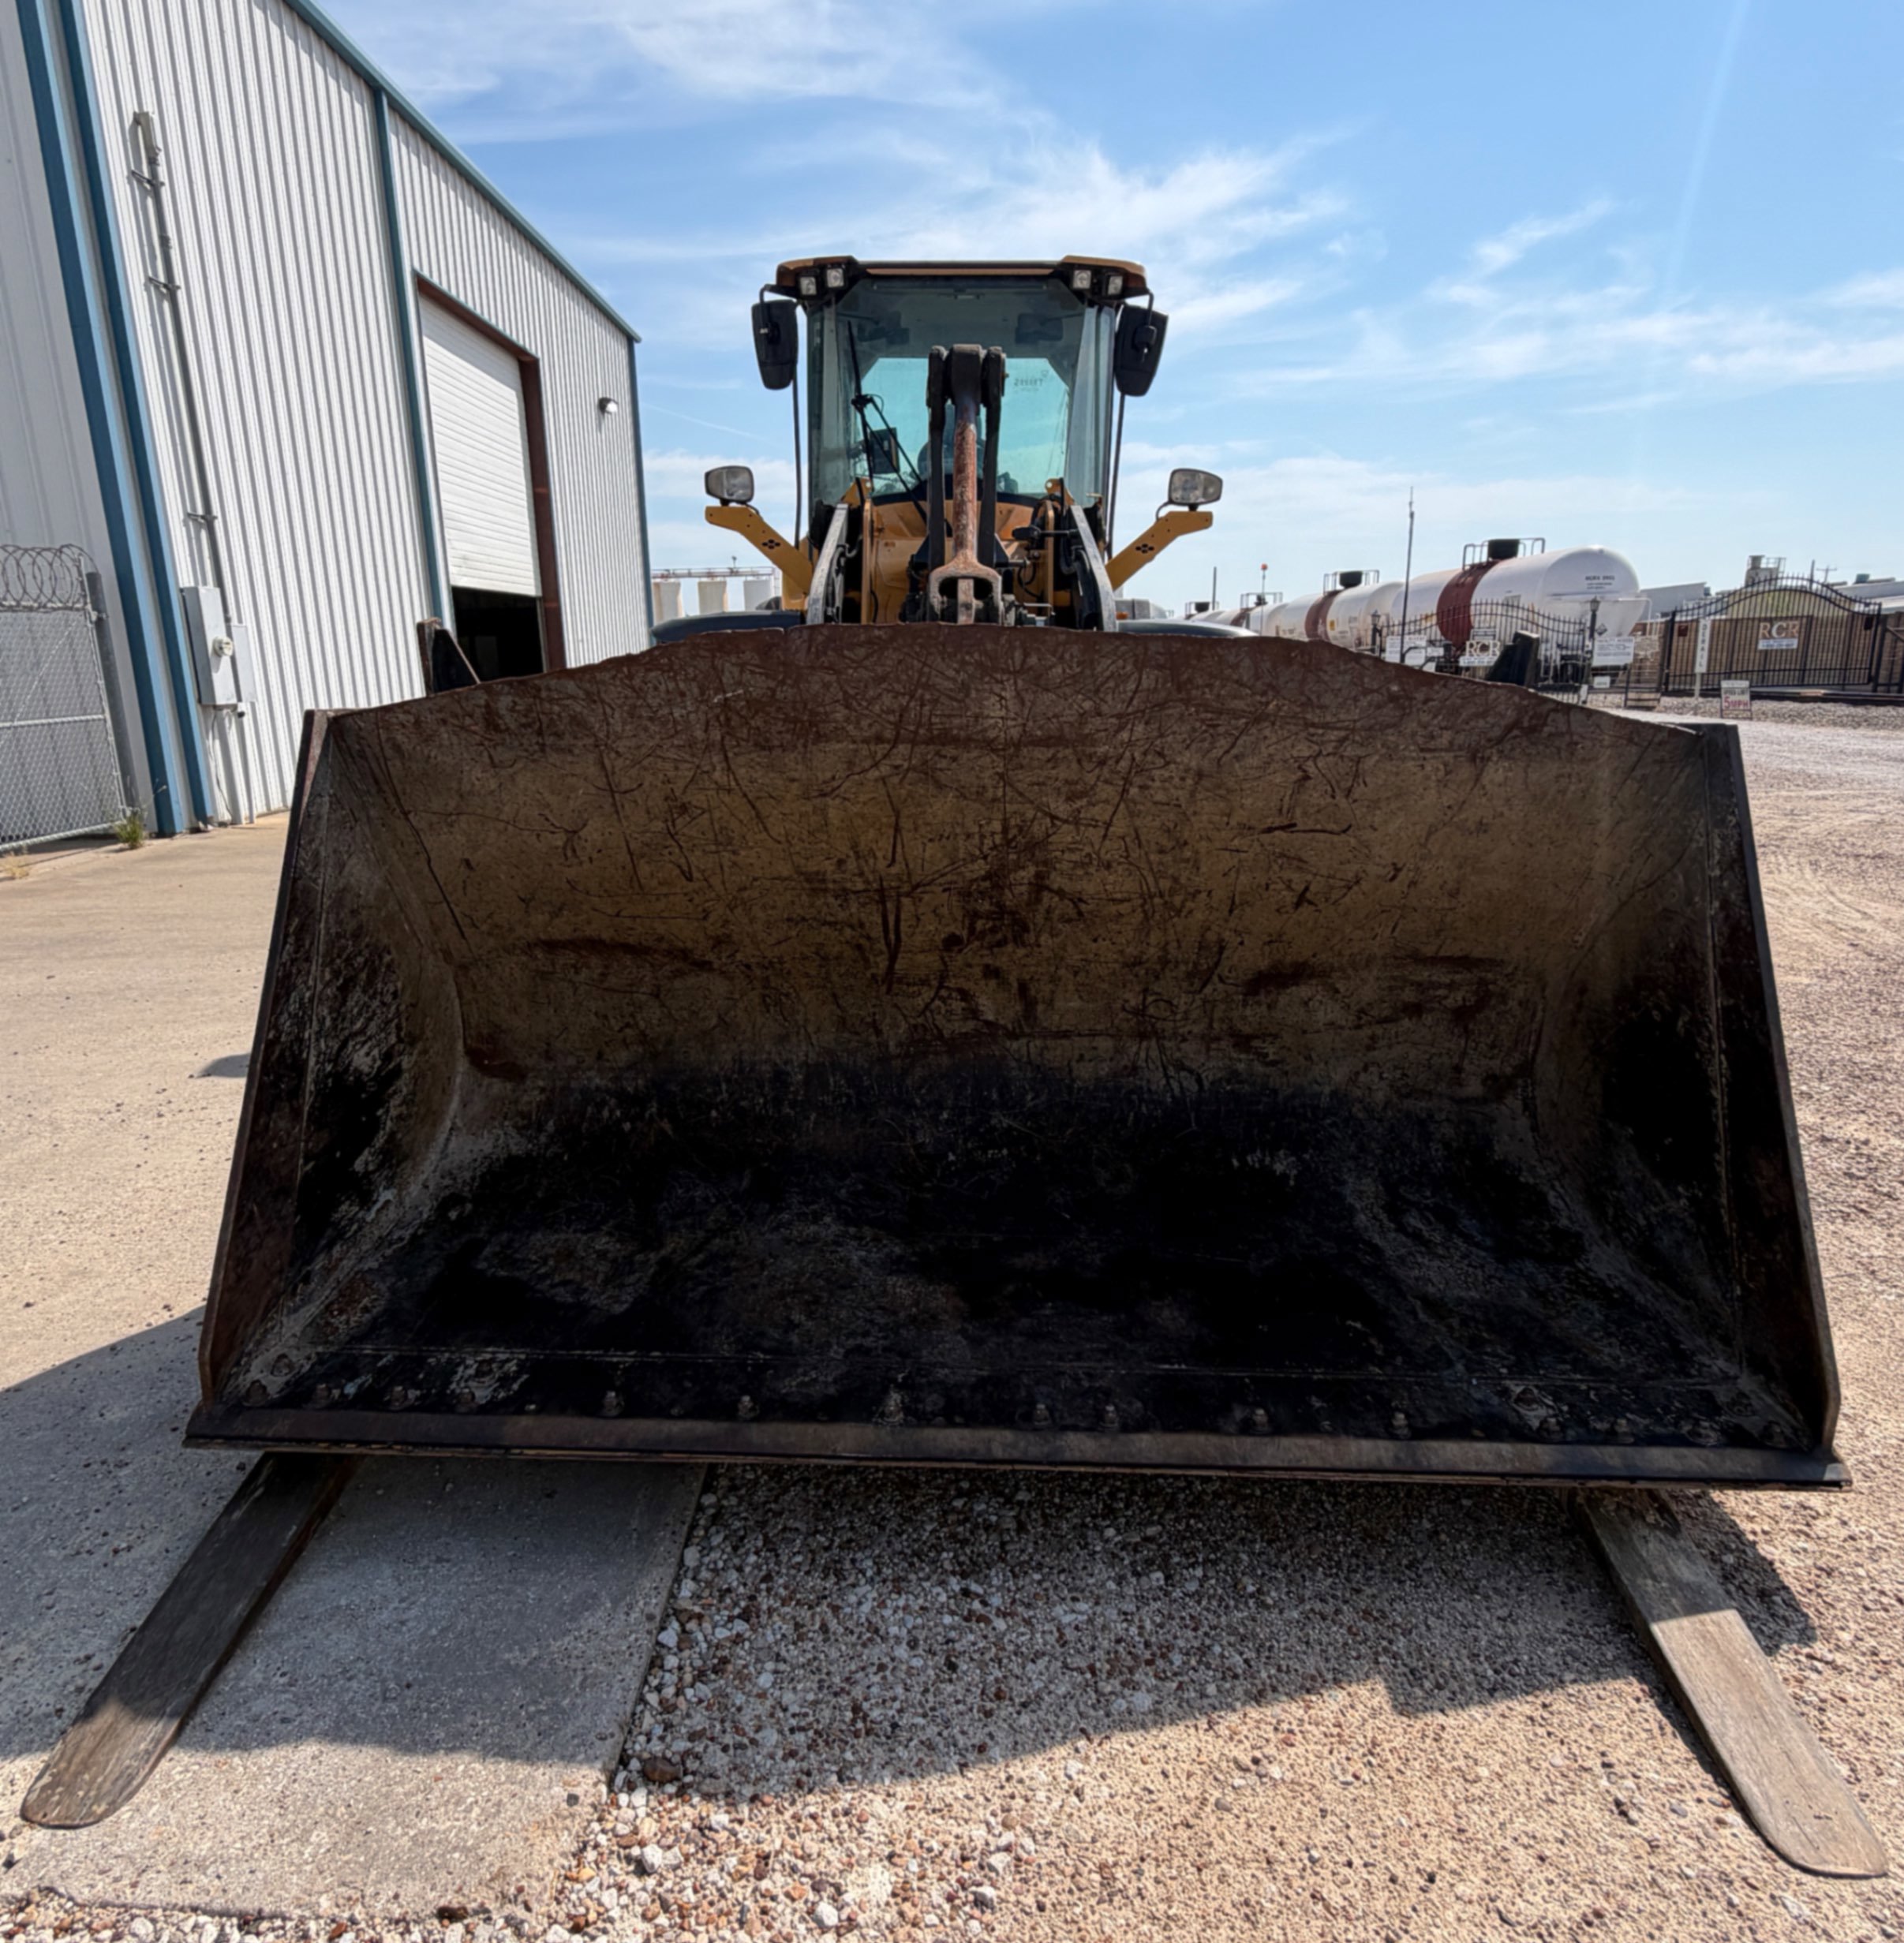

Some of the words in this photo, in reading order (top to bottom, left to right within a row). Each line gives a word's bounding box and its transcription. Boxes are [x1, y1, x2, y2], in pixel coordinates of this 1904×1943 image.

[1759, 622, 1799, 638] RCR
[1465, 641, 1501, 657] RCR
[1698, 623, 1708, 668] DERAIL
